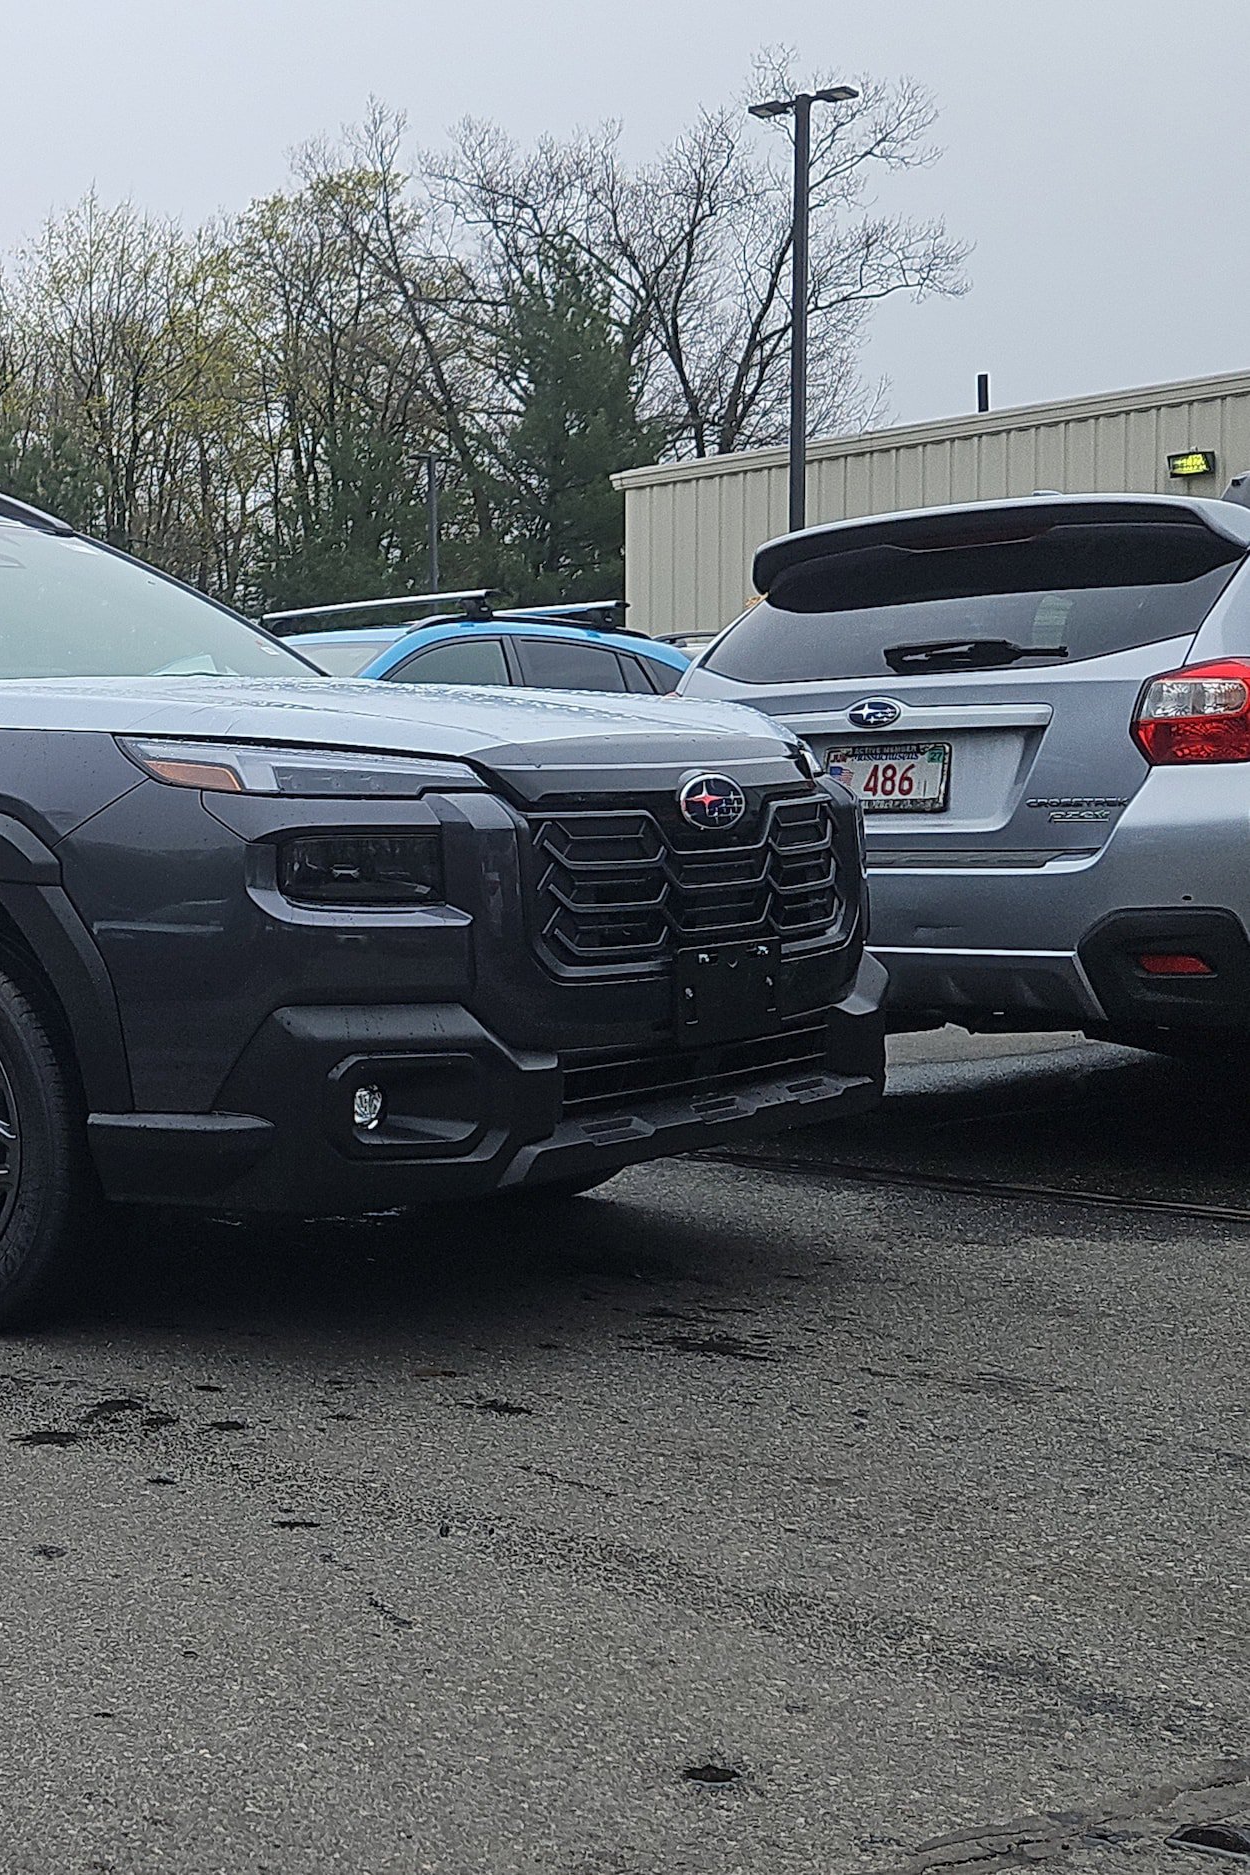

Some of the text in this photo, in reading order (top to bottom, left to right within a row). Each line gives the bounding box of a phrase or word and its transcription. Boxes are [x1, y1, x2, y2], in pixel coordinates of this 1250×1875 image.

[854, 747, 882, 755] ACTIVE
[930, 751, 943, 760] 27
[863, 763, 916, 797] 486
[1025, 797, 1129, 808] CROSSTREK
